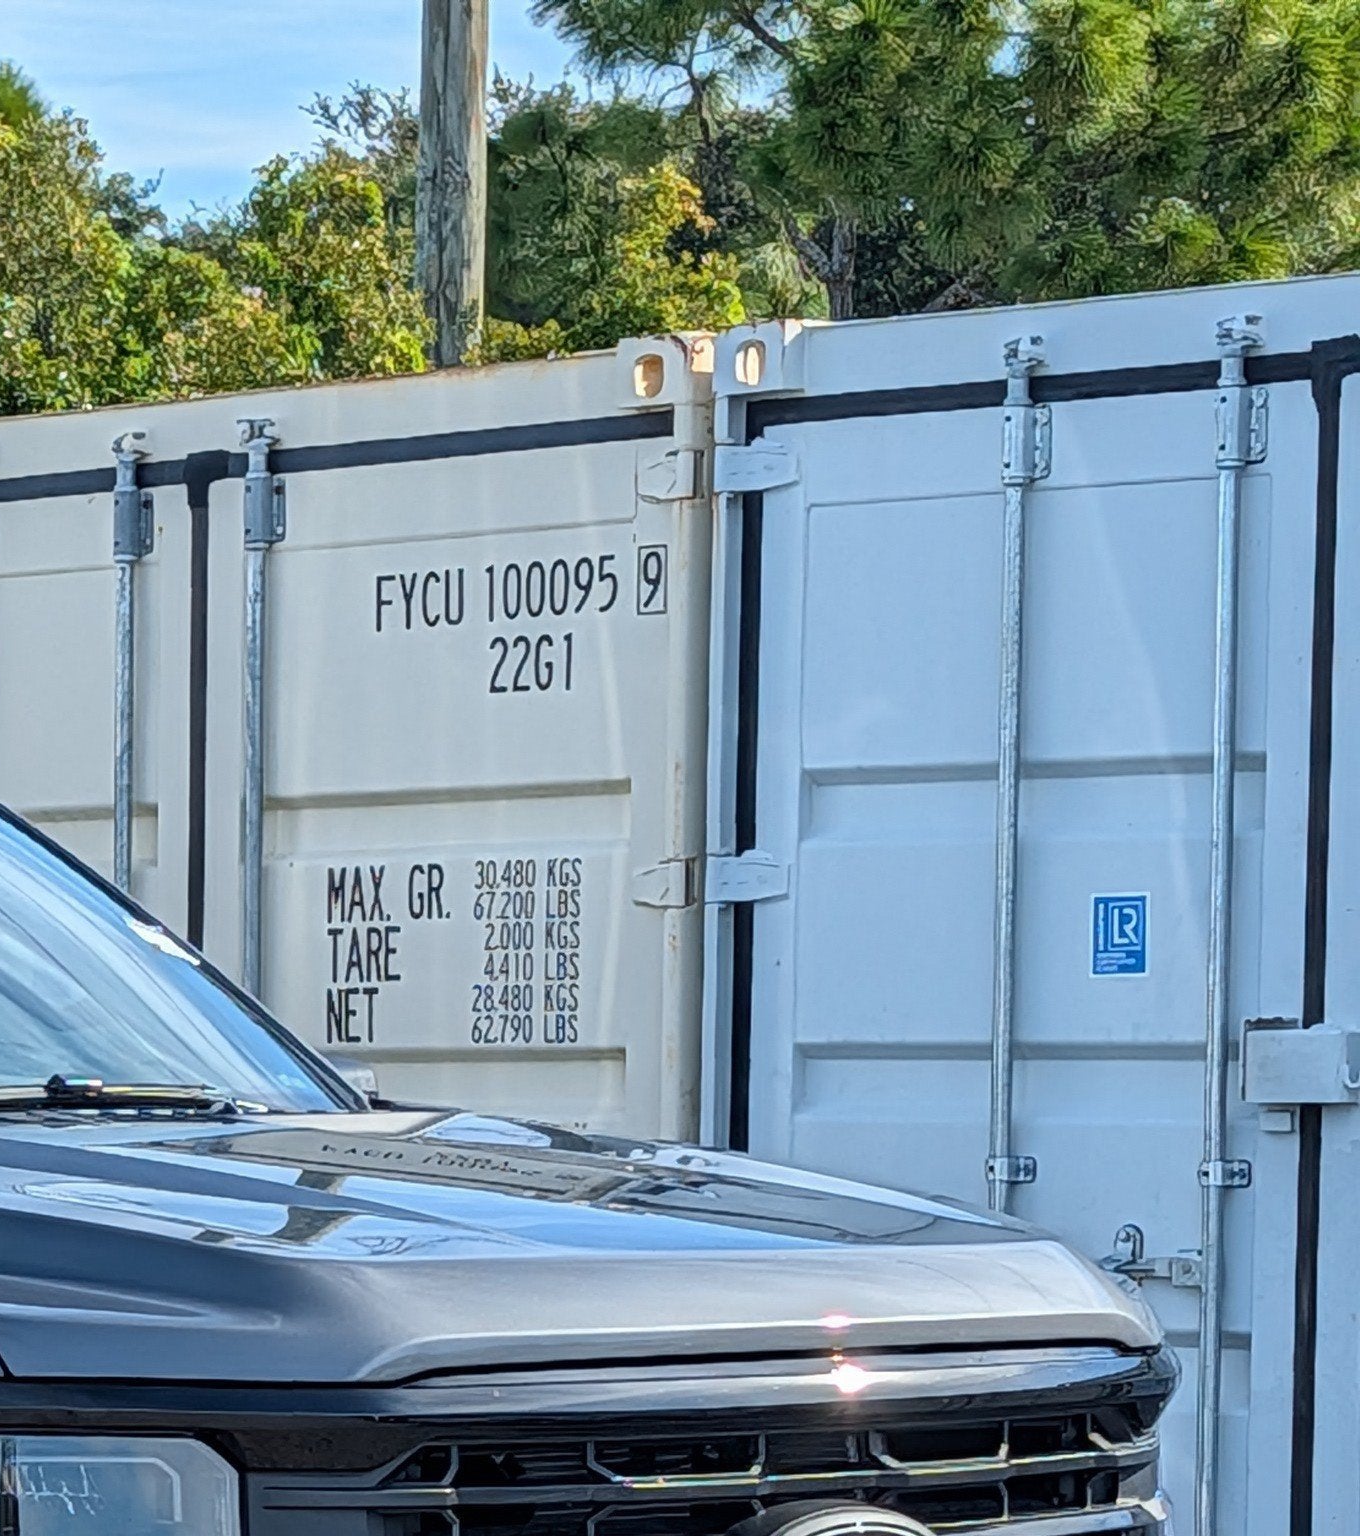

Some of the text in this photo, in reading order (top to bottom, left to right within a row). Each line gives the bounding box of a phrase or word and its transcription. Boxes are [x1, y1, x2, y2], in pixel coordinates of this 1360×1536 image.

[376, 548, 665, 632] FYCU 100095 9
[489, 632, 573, 693] 22G1
[327, 865, 391, 924] MAX.
[408, 863, 451, 920] GR.
[547, 858, 582, 887] KGS
[546, 889, 581, 919] LBS
[327, 926, 401, 983] TARE
[545, 921, 581, 950] KGS
[544, 952, 580, 981] LBS
[327, 987, 379, 1044] NET
[543, 983, 580, 1012] KGS
[543, 1014, 578, 1044] LBS
